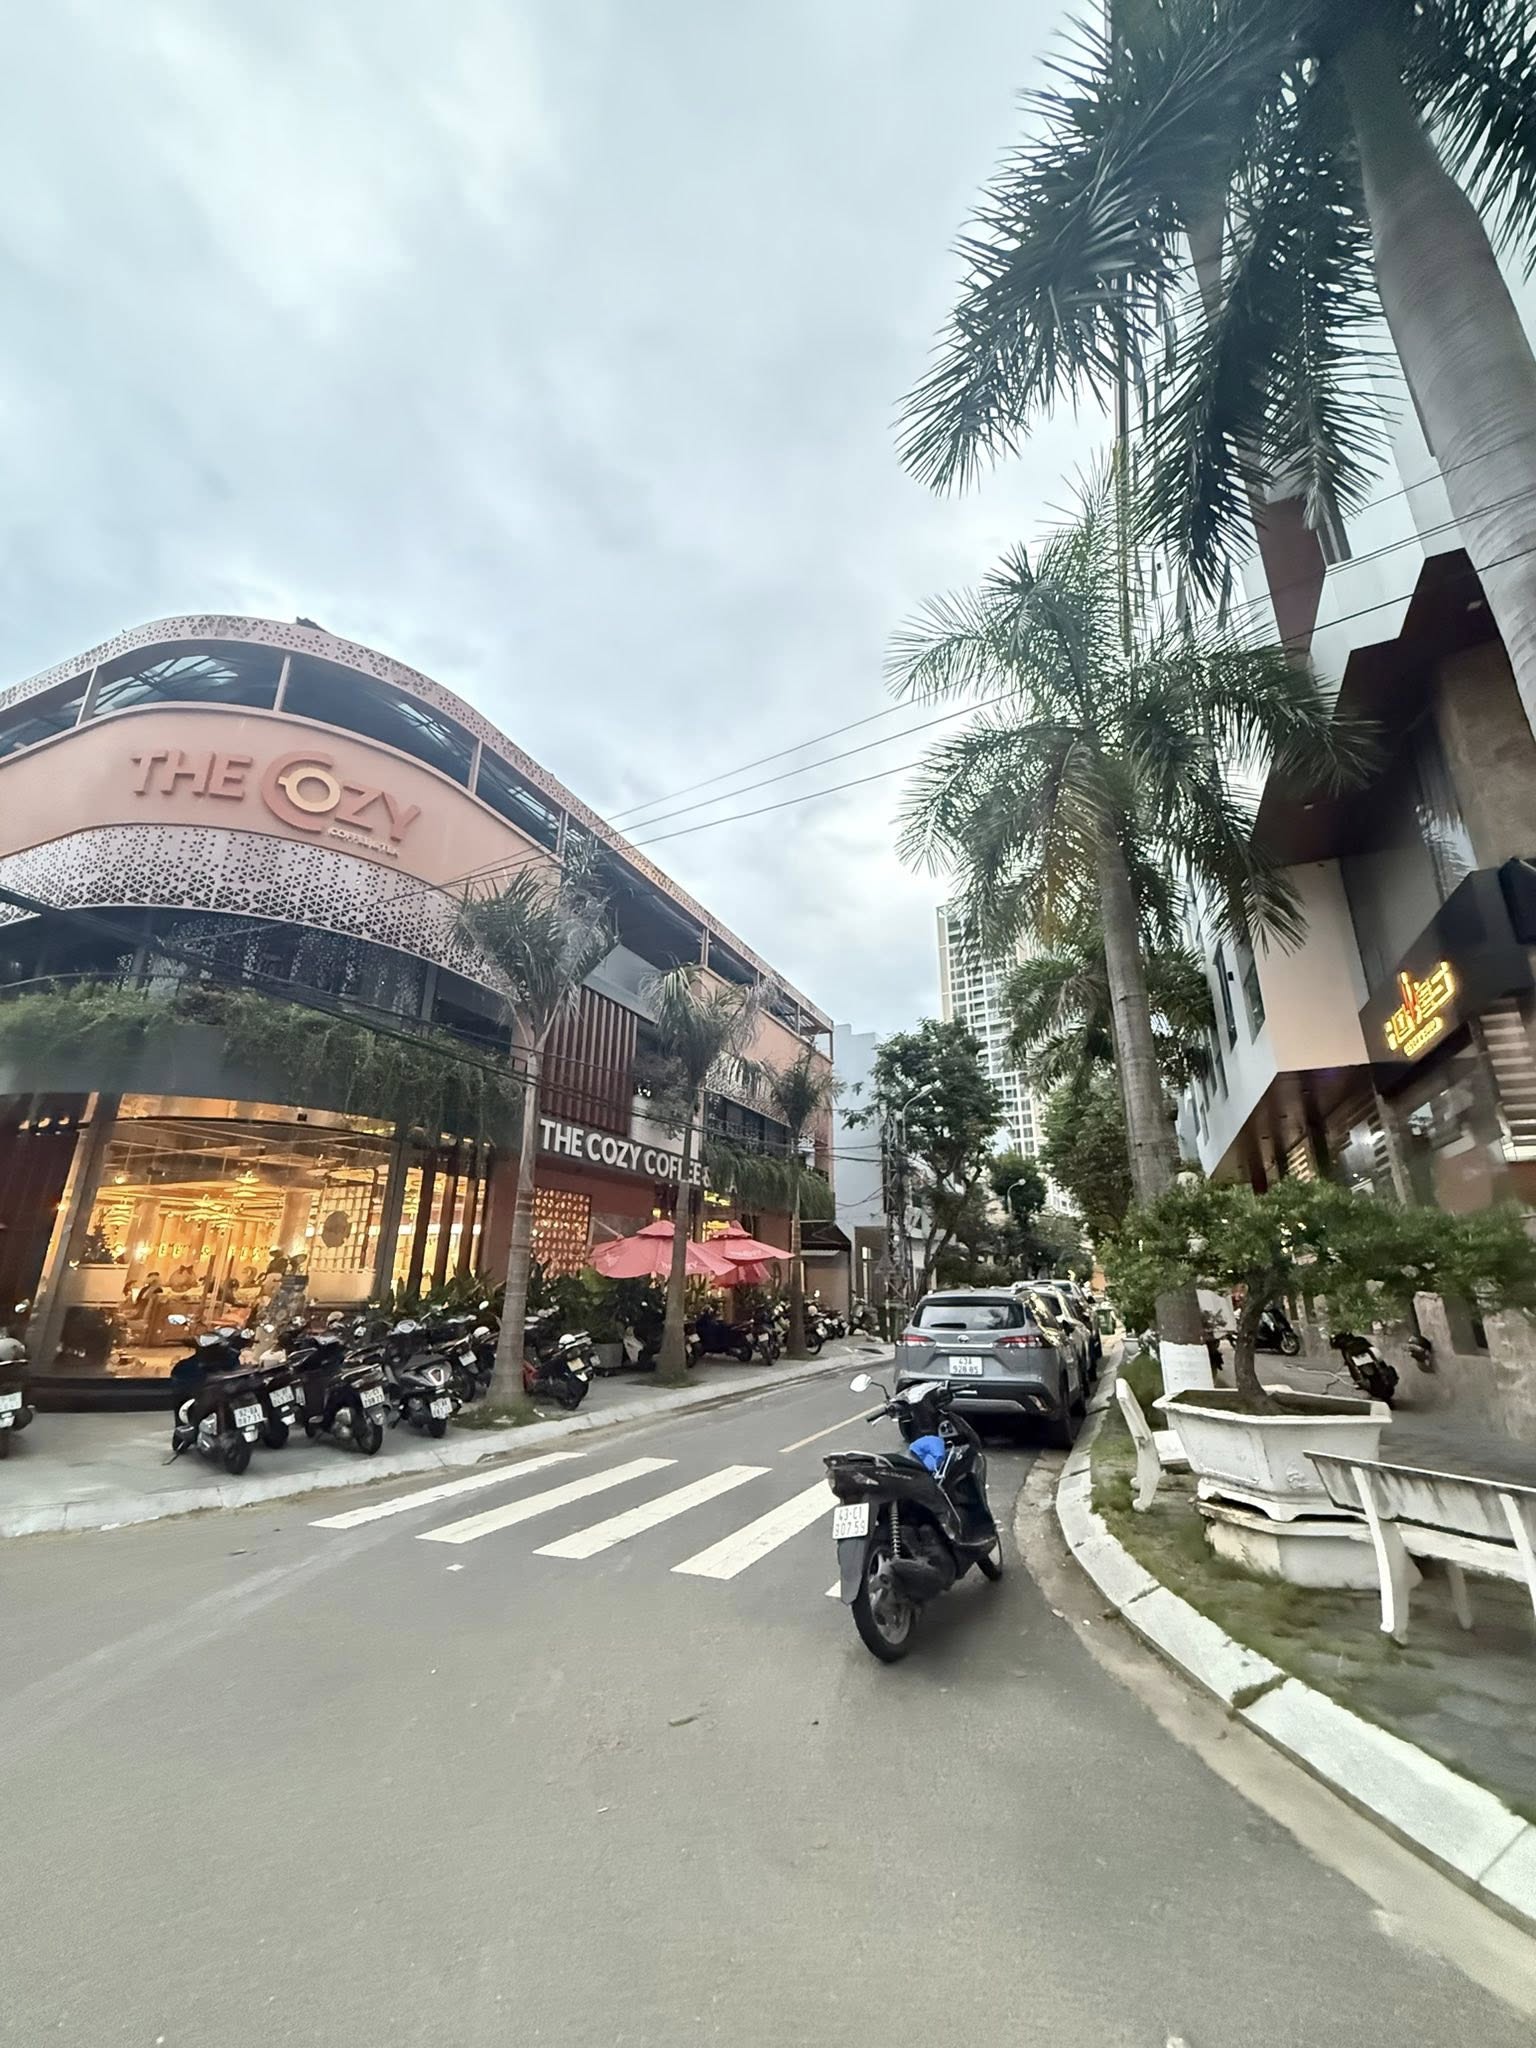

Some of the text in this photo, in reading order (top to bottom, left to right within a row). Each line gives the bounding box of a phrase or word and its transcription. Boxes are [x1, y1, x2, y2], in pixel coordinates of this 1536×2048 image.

[130, 750, 421, 841] THE COZY
[540, 1119, 584, 1158] THE
[586, 1133, 642, 1171] COZY
[839, 1505, 862, 1521] 43-C1
